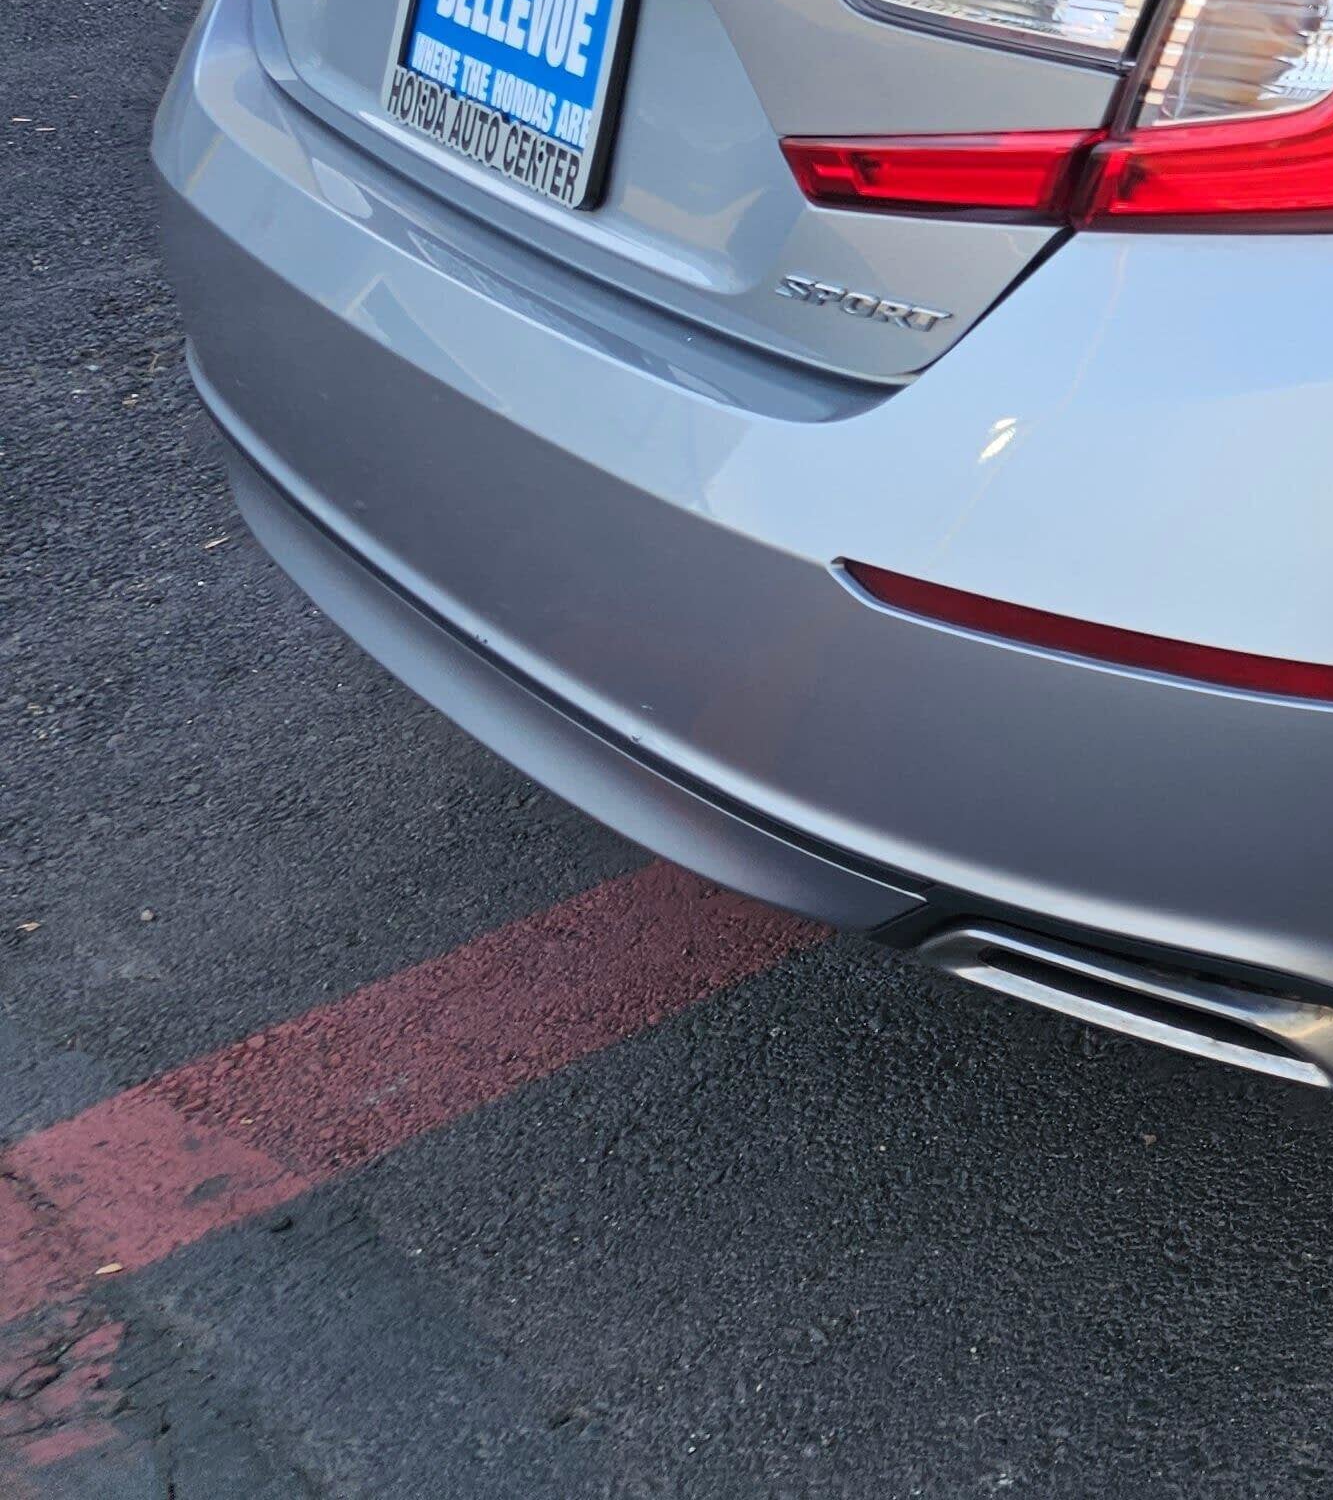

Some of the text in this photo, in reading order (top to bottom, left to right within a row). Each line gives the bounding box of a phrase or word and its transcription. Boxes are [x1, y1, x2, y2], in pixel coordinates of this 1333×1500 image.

[387, 70, 581, 204] HONDA AUTO CENTER
[411, 31, 593, 149] WHERE THE HONDAS ARE
[774, 274, 954, 332] SPORT
